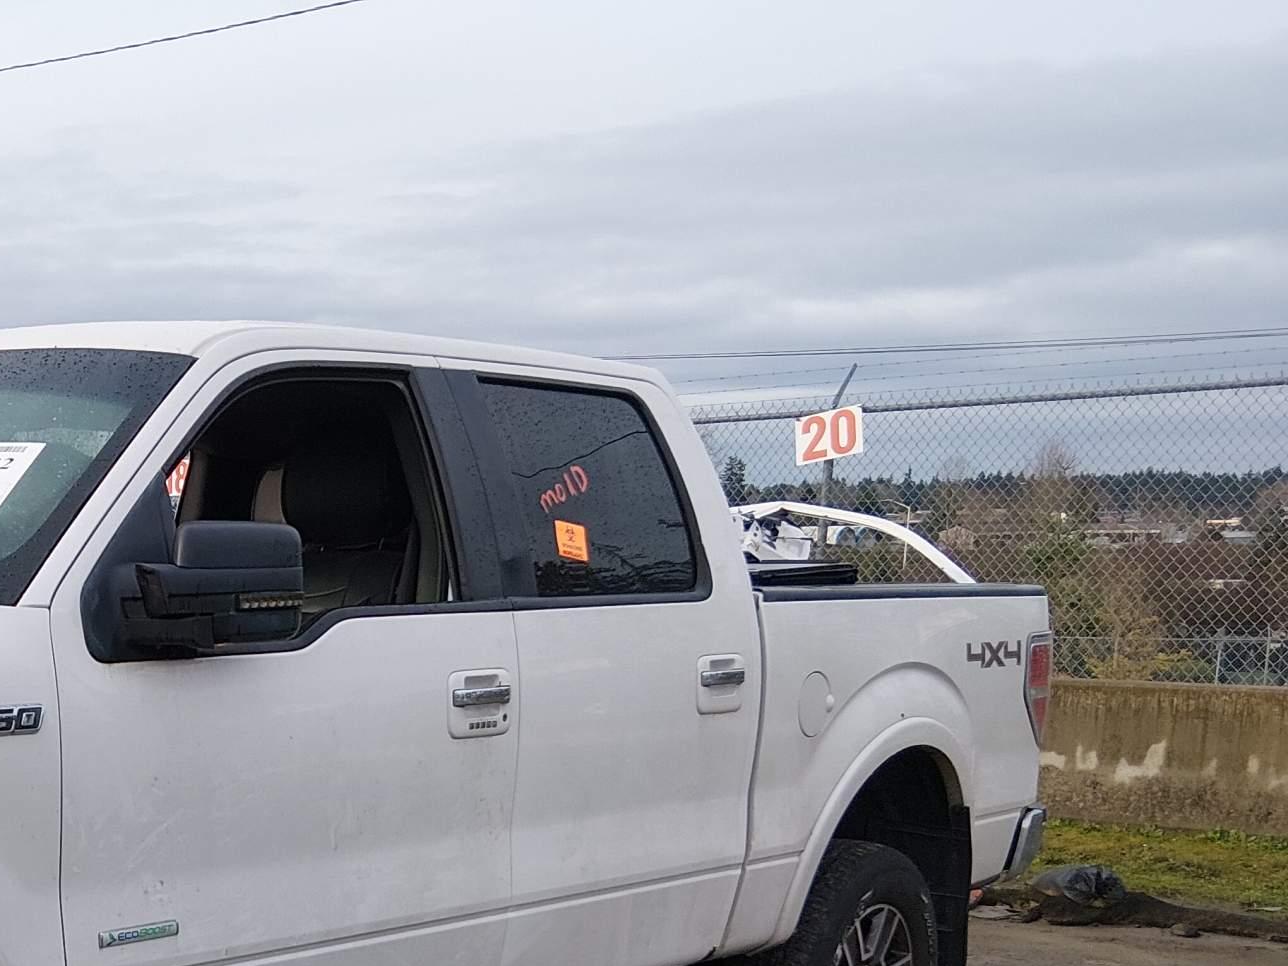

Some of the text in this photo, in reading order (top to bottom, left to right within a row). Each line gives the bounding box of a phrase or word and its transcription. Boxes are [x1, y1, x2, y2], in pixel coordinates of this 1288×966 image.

[801, 409, 857, 461] 20
[966, 640, 1021, 669] 4X4
[118, 924, 175, 941] ECOBOOST
